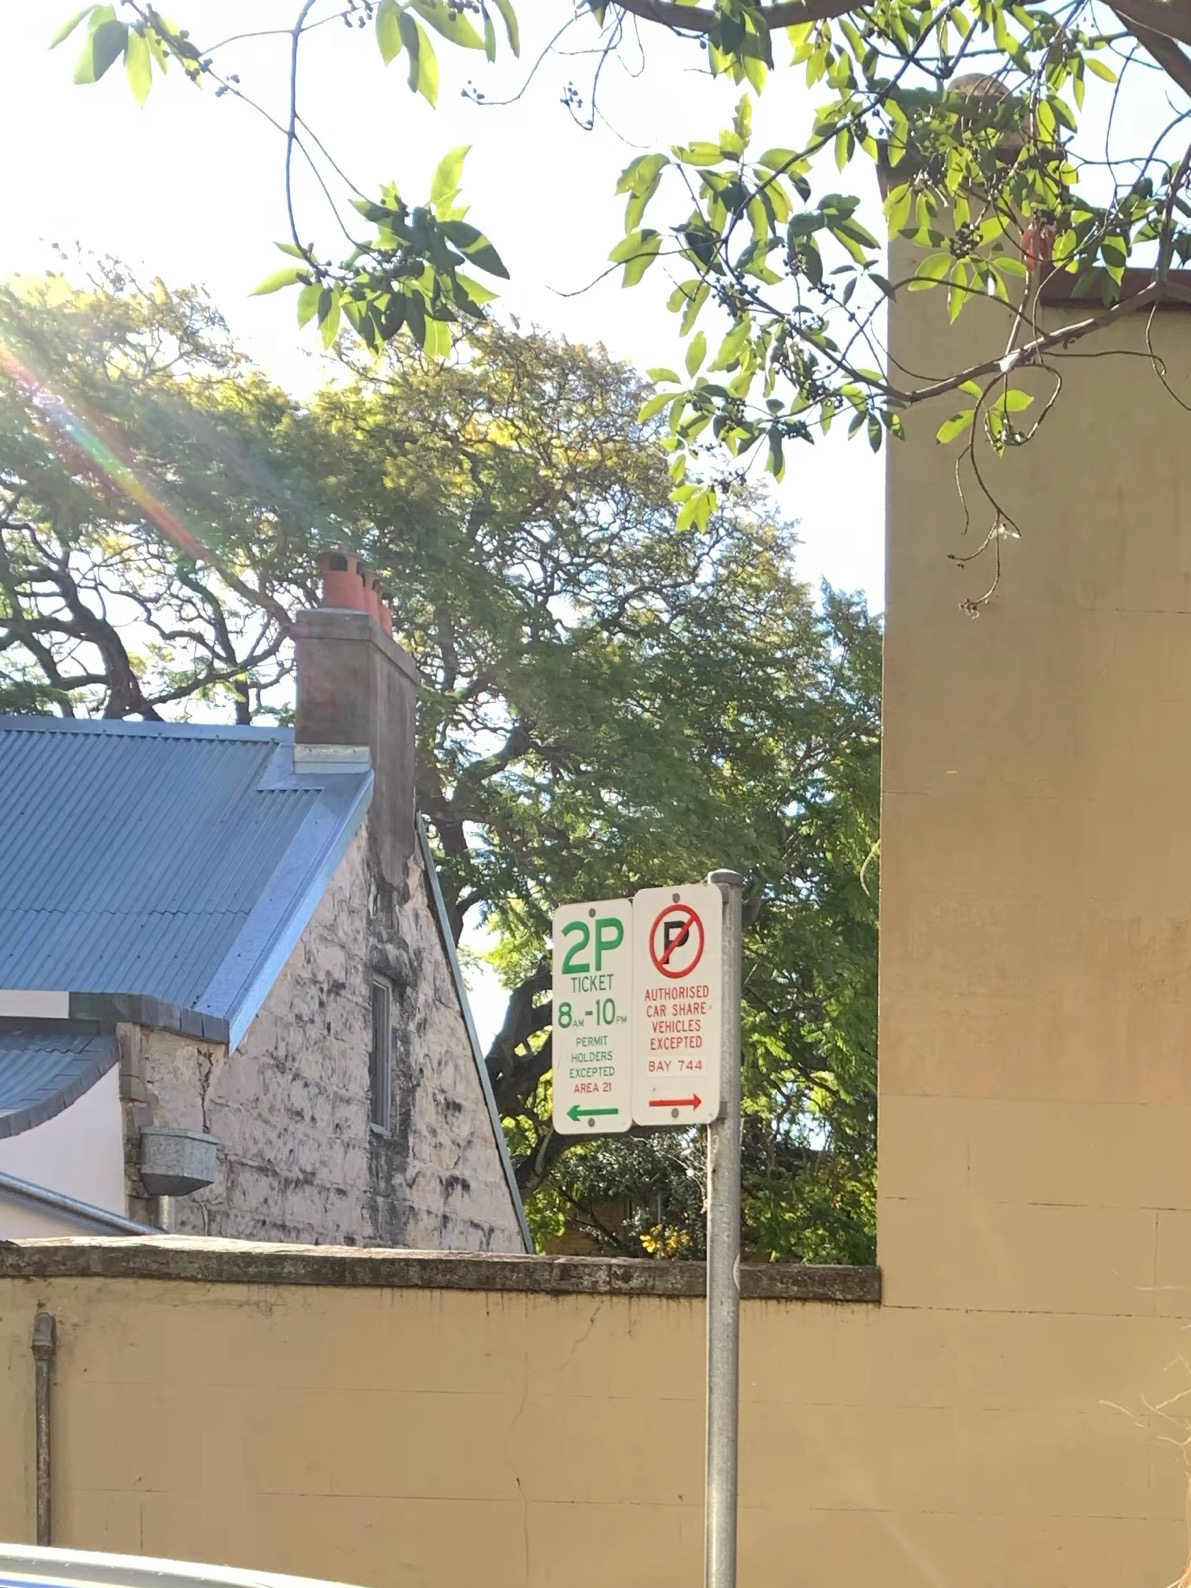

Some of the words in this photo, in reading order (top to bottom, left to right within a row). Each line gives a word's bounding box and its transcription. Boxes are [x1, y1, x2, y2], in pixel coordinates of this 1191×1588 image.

[561, 917, 624, 975] 2P
[664, 920, 690, 965] P
[571, 974, 614, 993] TICKET
[644, 985, 709, 1002] AUTHORISED
[646, 1005, 668, 1018] CAR
[672, 1002, 706, 1017] SHARE
[652, 1019, 701, 1033] VEHICLES
[576, 1035, 608, 1047] PERMIT
[650, 1035, 703, 1051] EXCEPTED
[571, 1051, 613, 1063] HOLDERS
[569, 1066, 615, 1079] EXCEPTED
[648, 1061, 672, 1072] BAY
[678, 1060, 703, 1071] 744
[574, 1082, 599, 1094] AREA
[603, 1082, 612, 1092] 21
